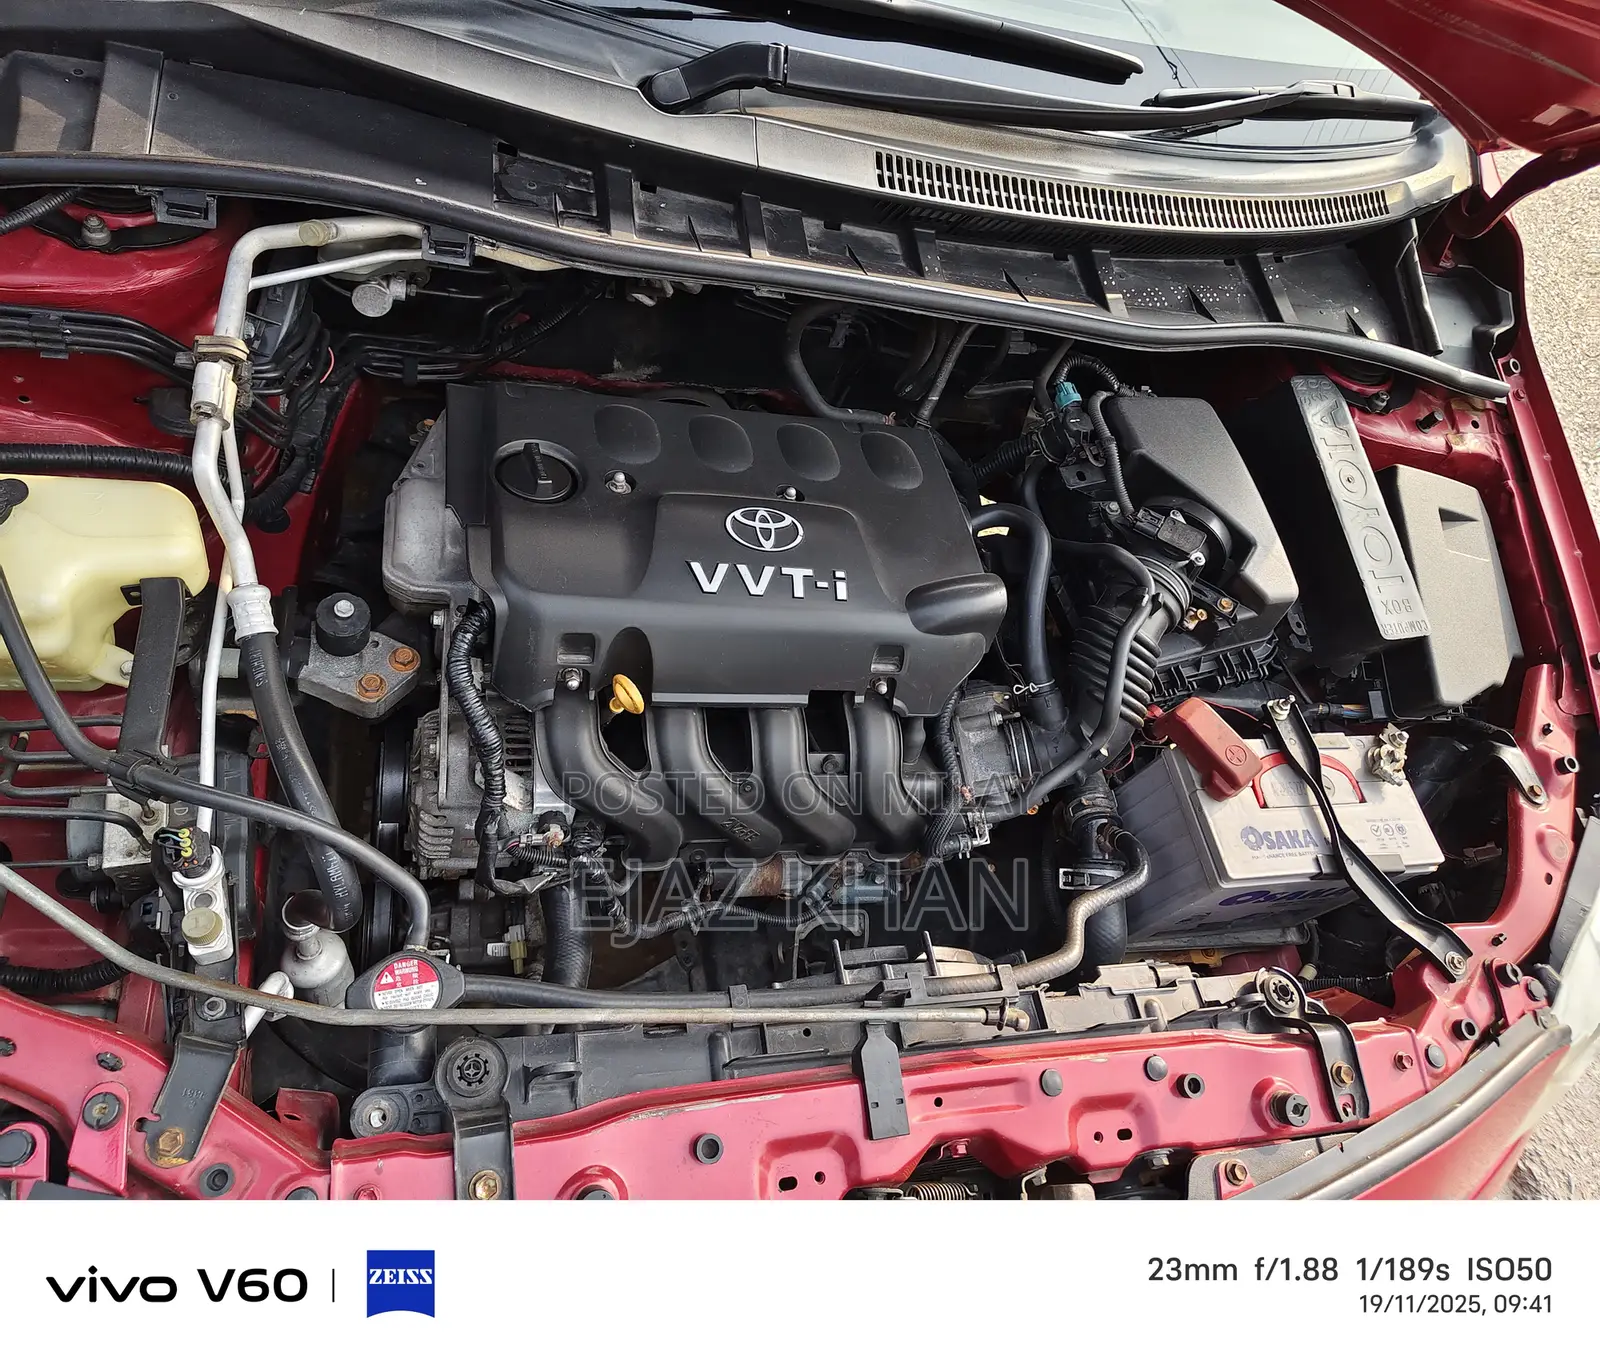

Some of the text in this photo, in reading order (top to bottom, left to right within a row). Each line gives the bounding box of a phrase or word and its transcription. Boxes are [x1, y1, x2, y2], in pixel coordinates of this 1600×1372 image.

[1311, 399, 1404, 594] TOYOTA
[686, 561, 848, 601] VVT-i
[1380, 598, 1413, 616] BOX
[1380, 618, 1430, 637] COMPUTER
[1240, 825, 1319, 851] OSAKA
[393, 959, 419, 970] DANGER
